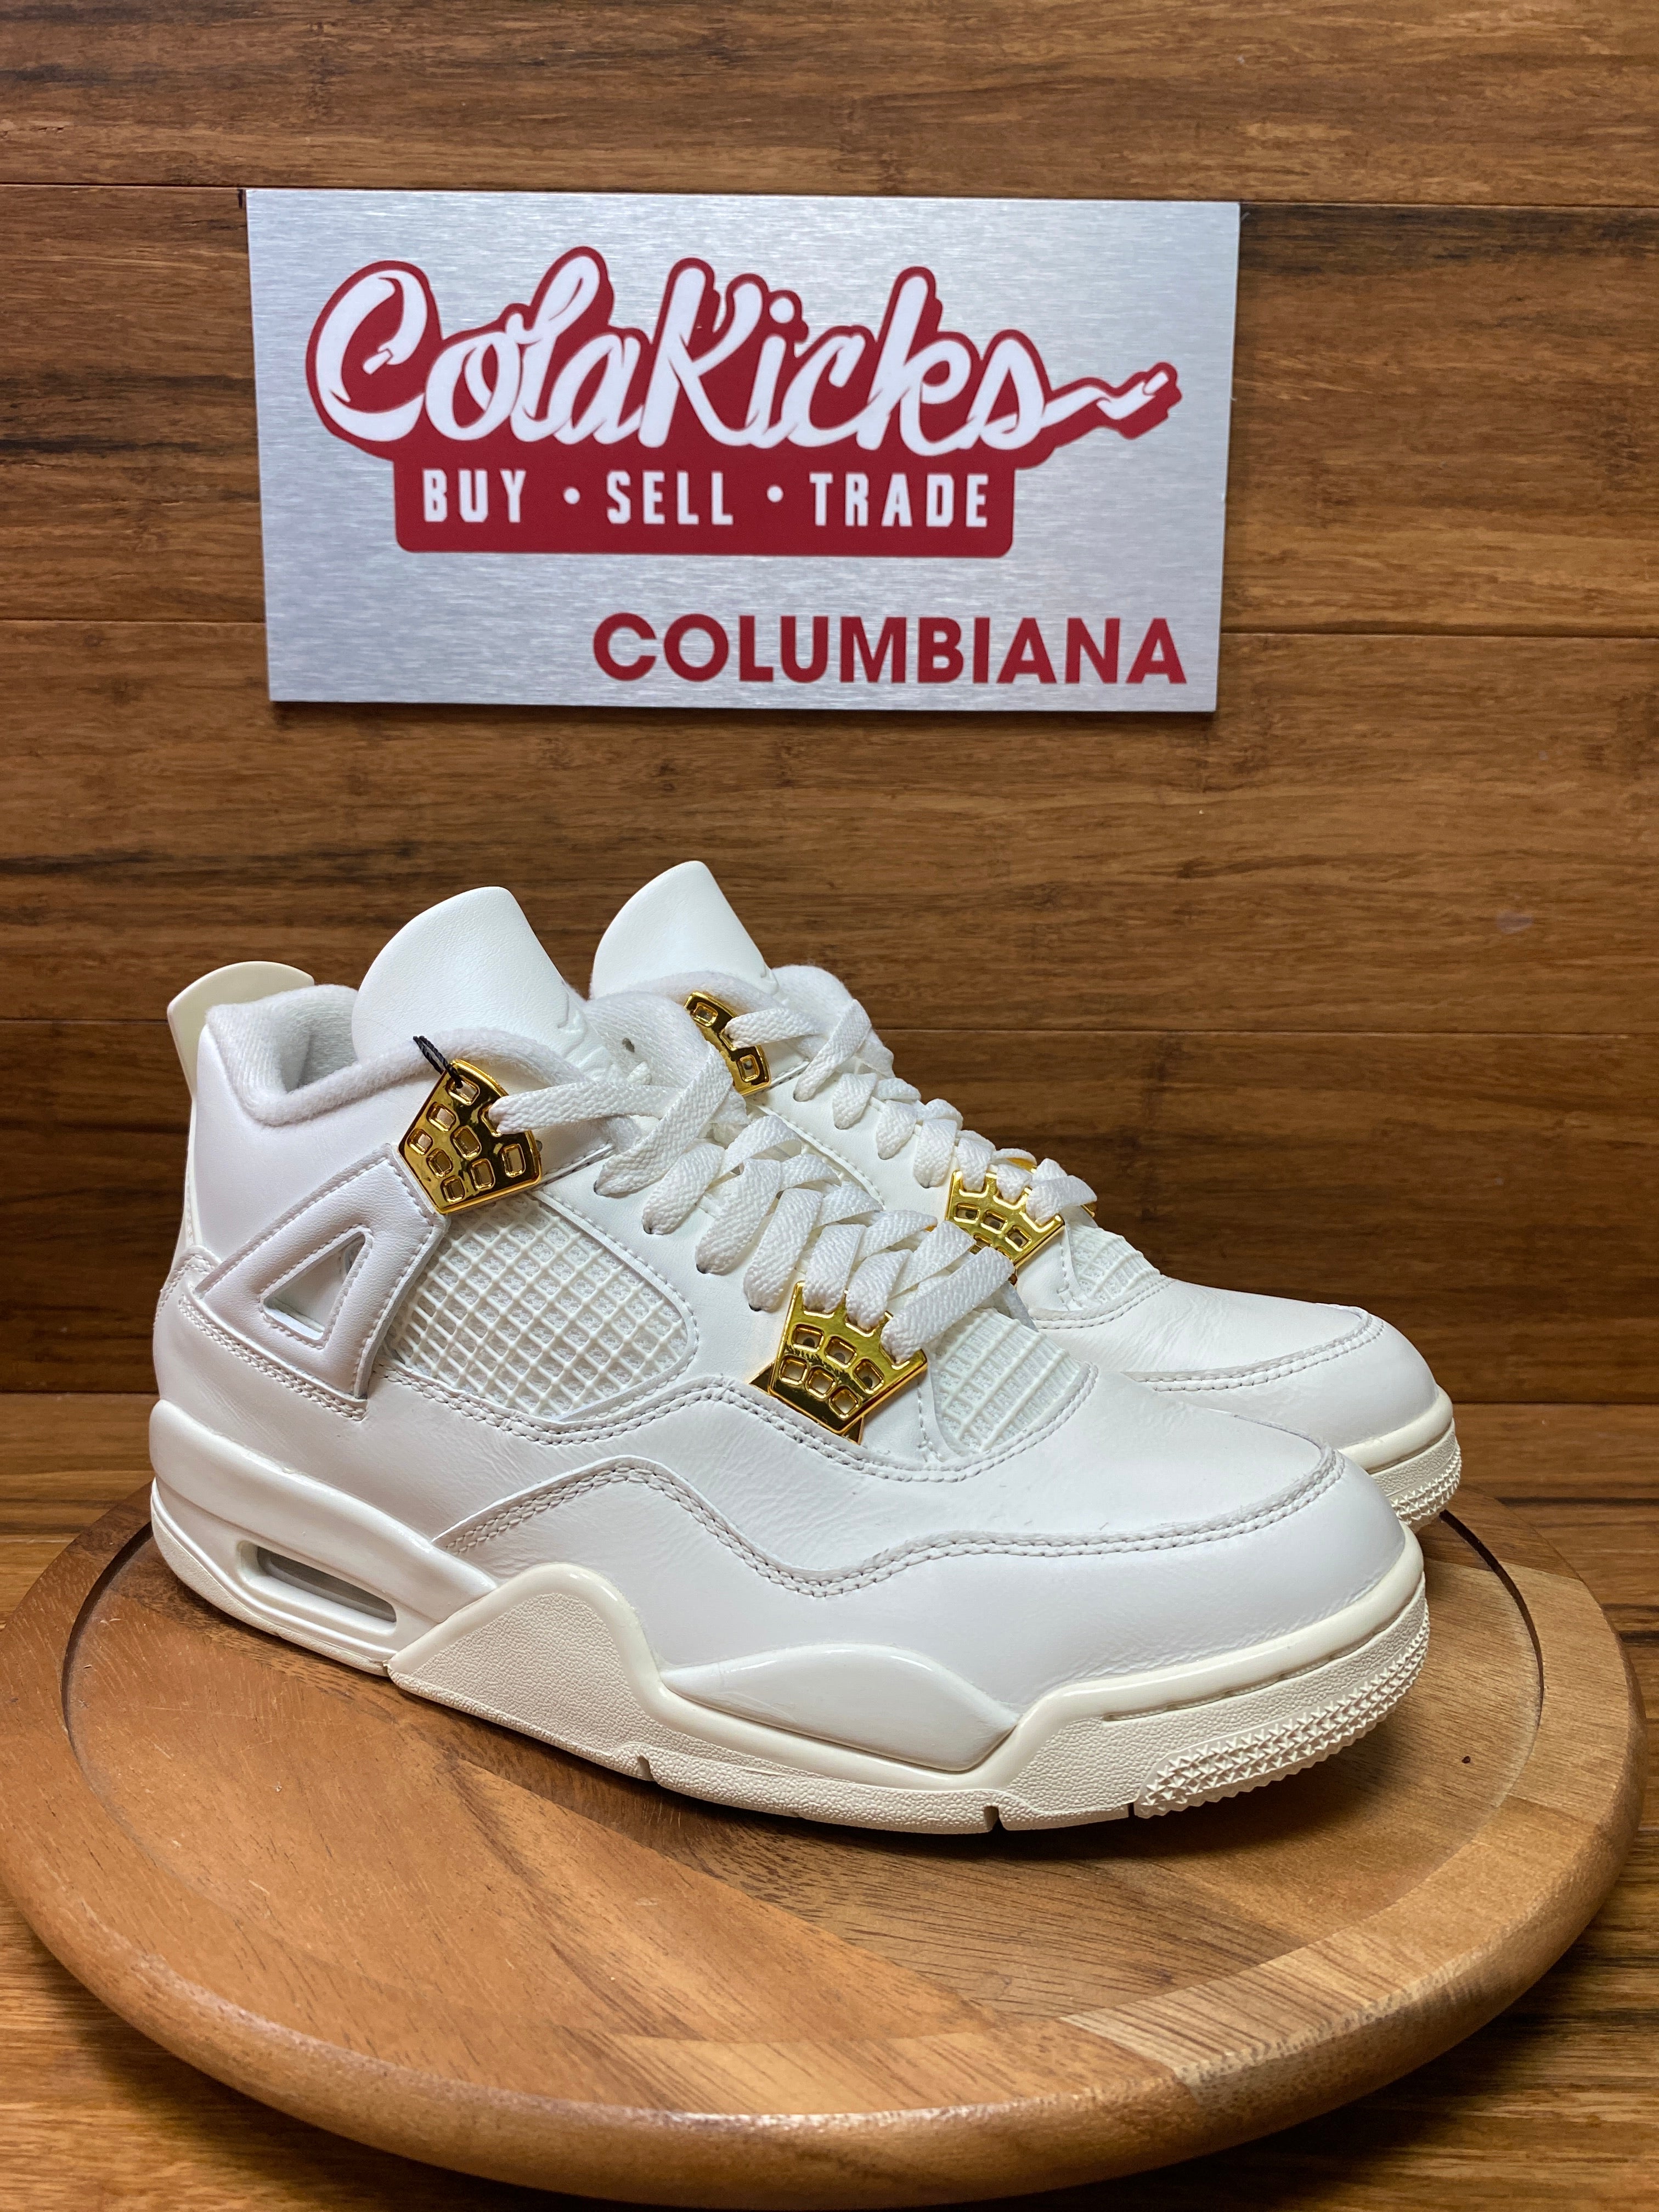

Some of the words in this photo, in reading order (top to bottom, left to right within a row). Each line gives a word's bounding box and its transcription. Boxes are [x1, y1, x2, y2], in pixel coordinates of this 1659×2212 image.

[315, 253, 1169, 456] ColaKicks
[423, 469, 526, 523] BUY
[607, 471, 733, 525] SELL
[809, 473, 989, 527] TRADE
[593, 613, 1187, 684] COLUMBIANA
